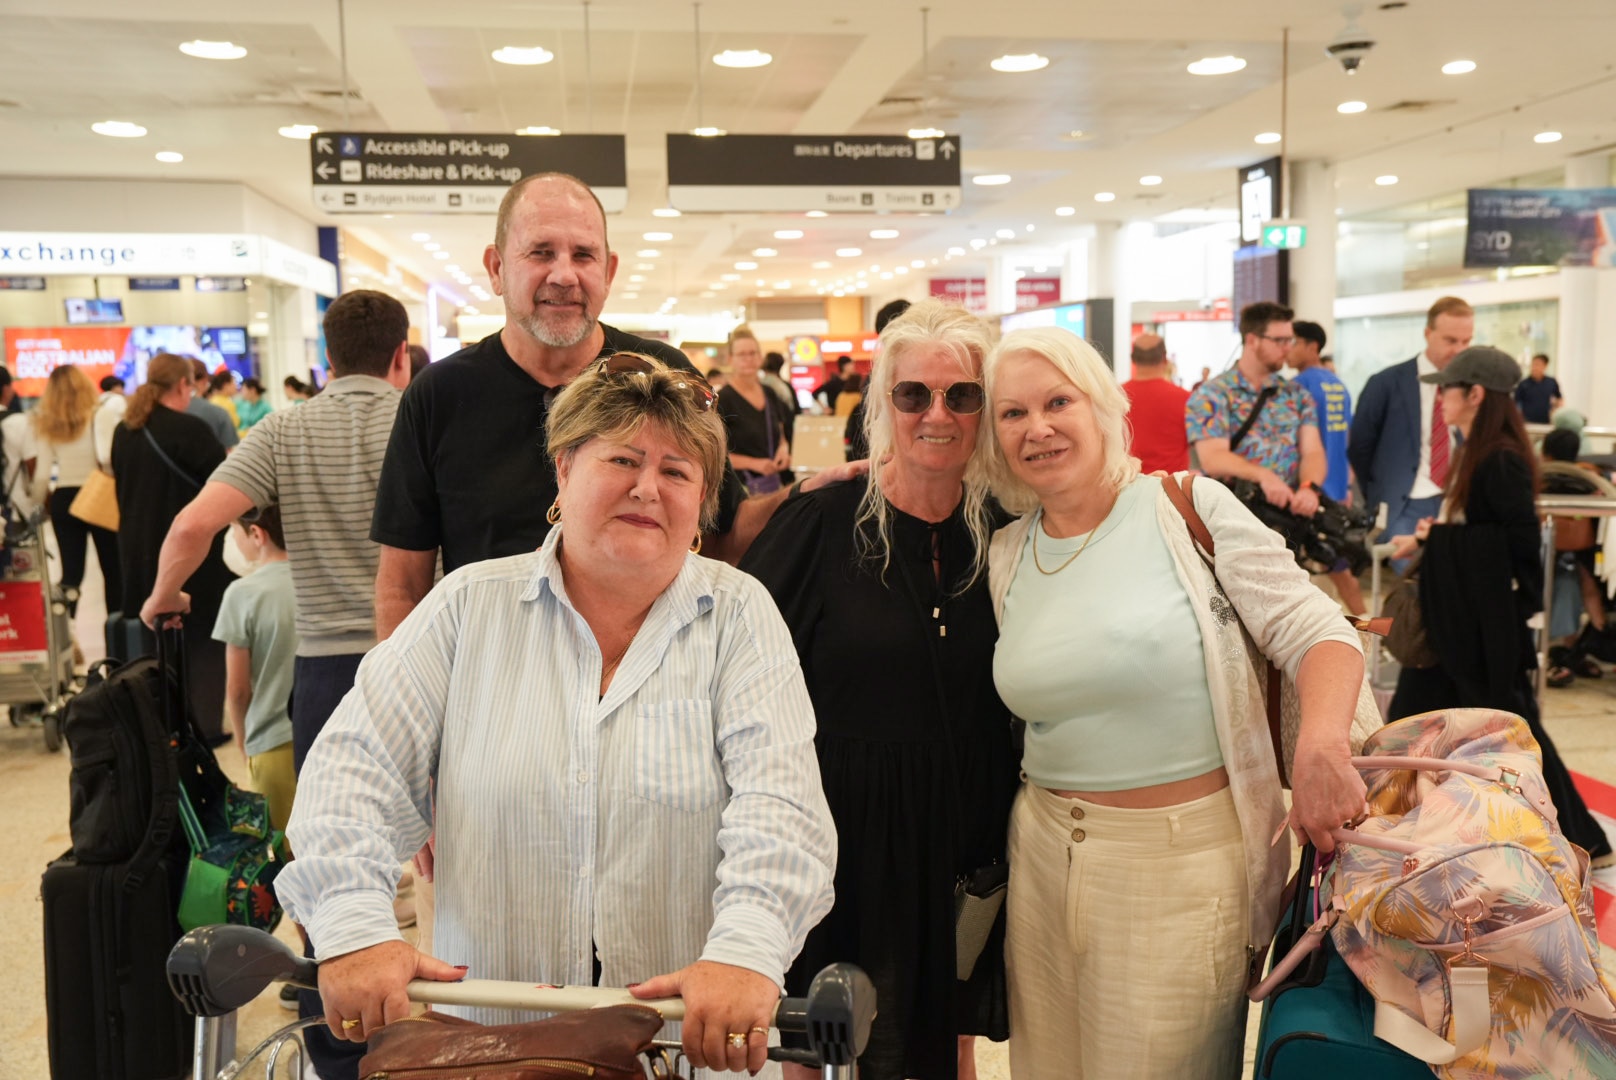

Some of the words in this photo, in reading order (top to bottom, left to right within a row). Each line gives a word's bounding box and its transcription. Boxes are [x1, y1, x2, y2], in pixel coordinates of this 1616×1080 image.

[364, 138, 447, 156] Accessible
[449, 139, 510, 160] Pick-up
[833, 141, 914, 160] Departures
[365, 163, 444, 180] Rideshare
[446, 163, 460, 180] &
[461, 163, 522, 183] Pick-up
[826, 193, 857, 204] Buses
[885, 193, 916, 204] Trains
[1472, 230, 1513, 250] SYD
[16, 350, 115, 365] AUSTRALIAN
